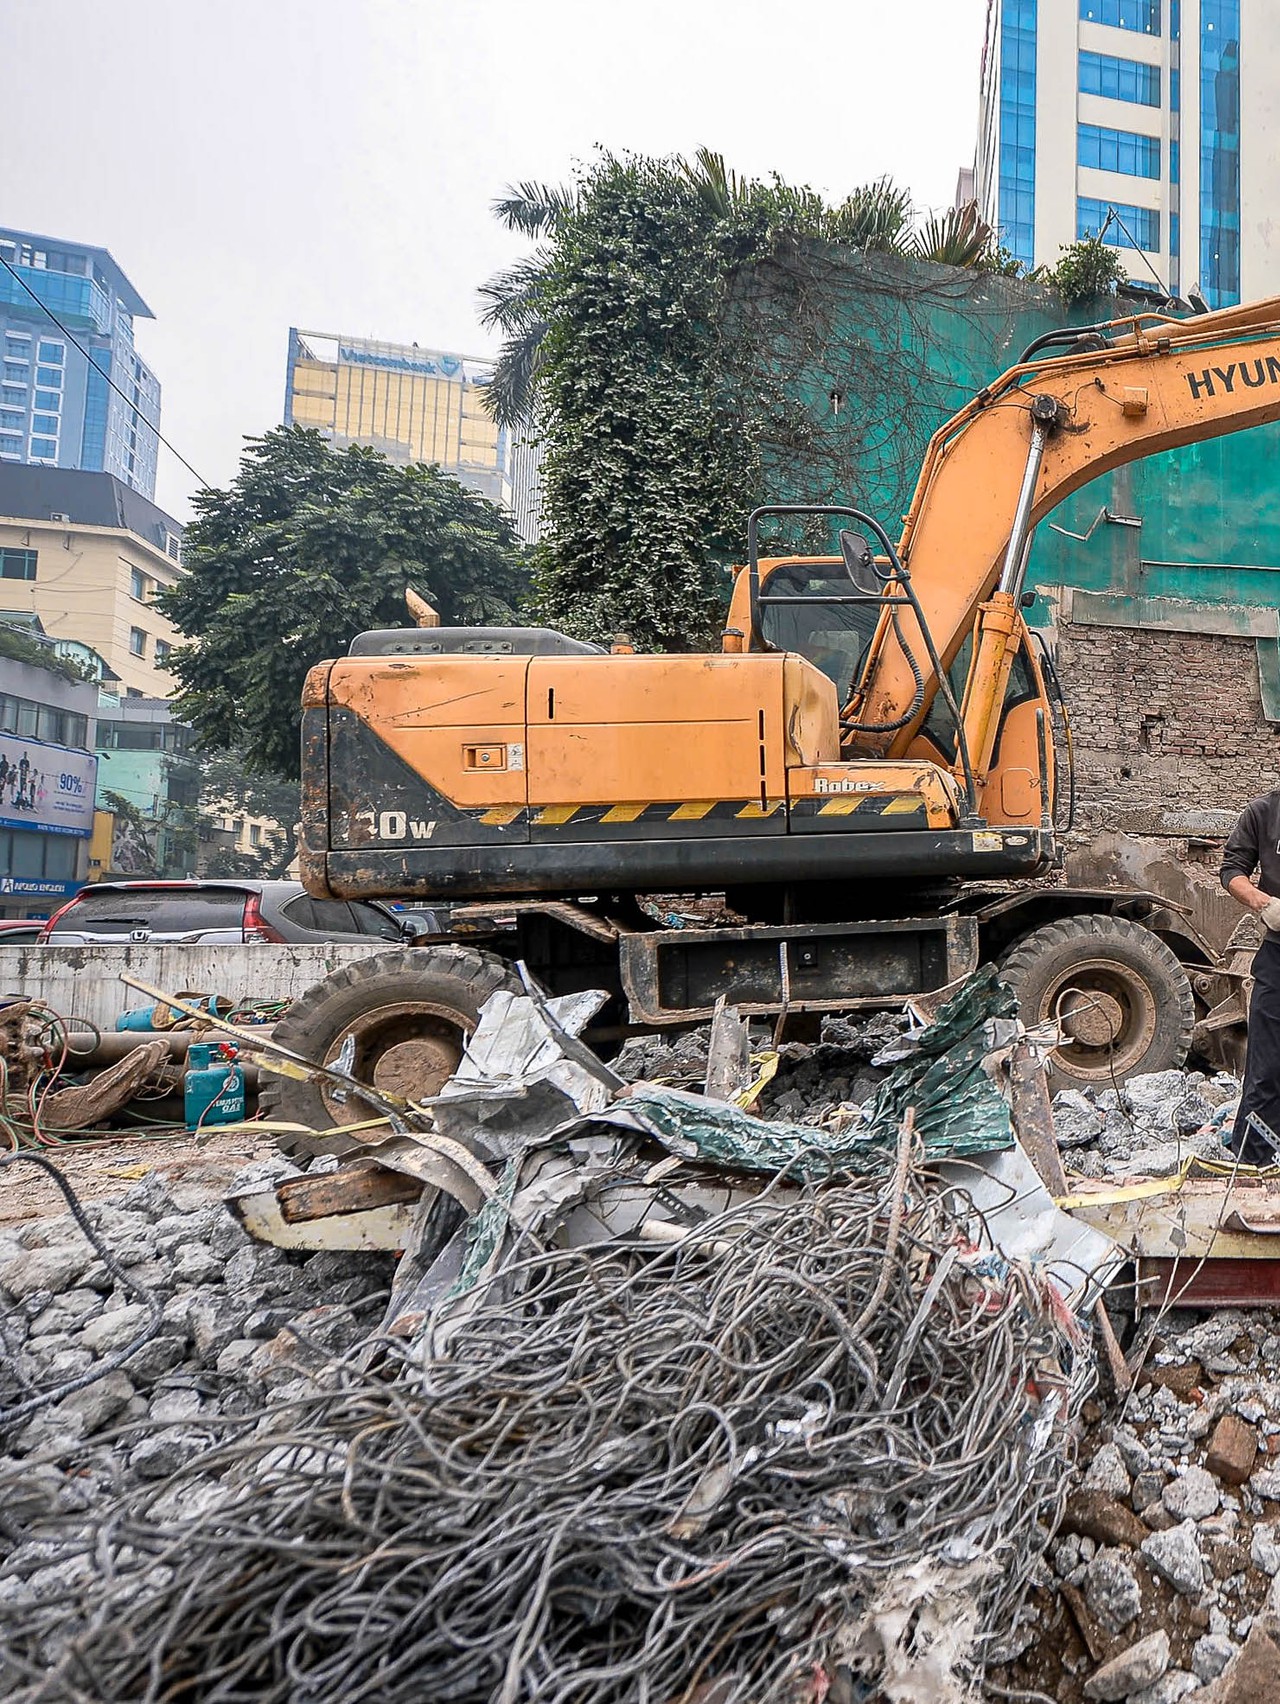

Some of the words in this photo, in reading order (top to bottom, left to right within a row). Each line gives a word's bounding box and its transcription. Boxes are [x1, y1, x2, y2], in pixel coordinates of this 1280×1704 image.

[340, 347, 437, 375] Vietcombank
[59, 773, 83, 793] 90%
[815, 777, 885, 793] Robex
